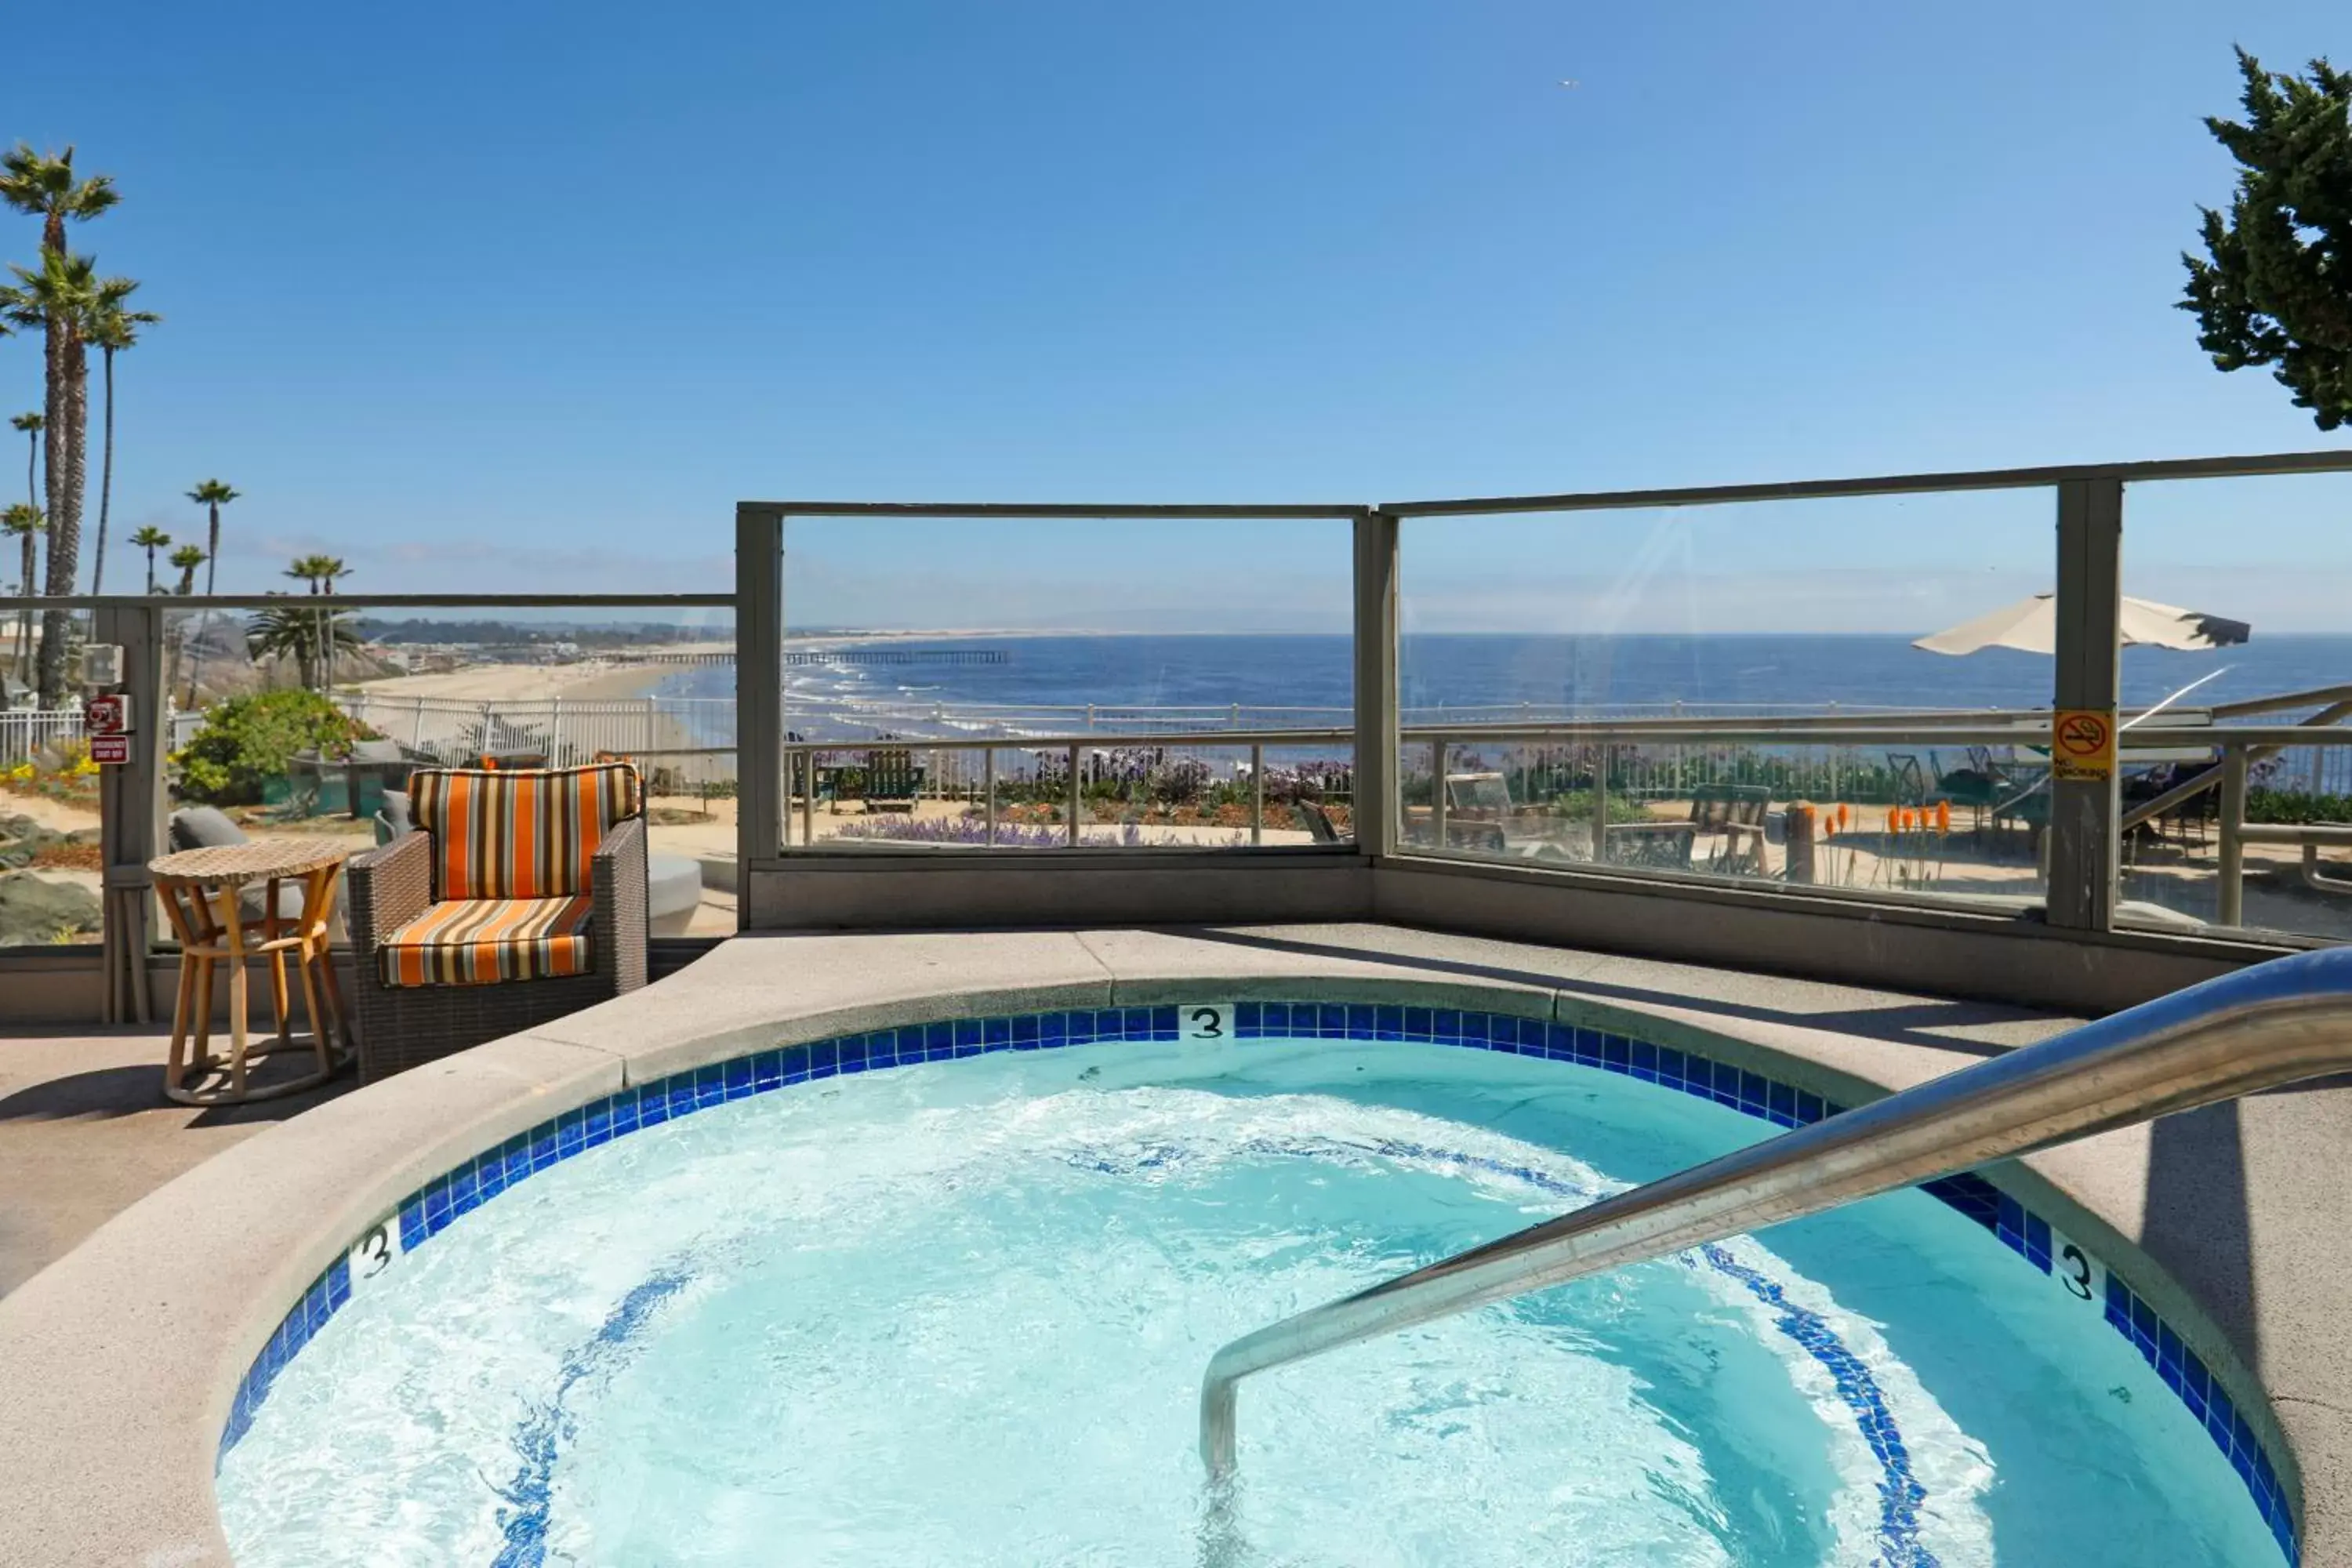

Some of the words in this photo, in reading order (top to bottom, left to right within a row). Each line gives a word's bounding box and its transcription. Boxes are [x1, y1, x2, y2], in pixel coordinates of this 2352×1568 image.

[1191, 1007, 1223, 1039] 3
[362, 1224, 391, 1279] 3
[2061, 1243, 2092, 1301] 3
